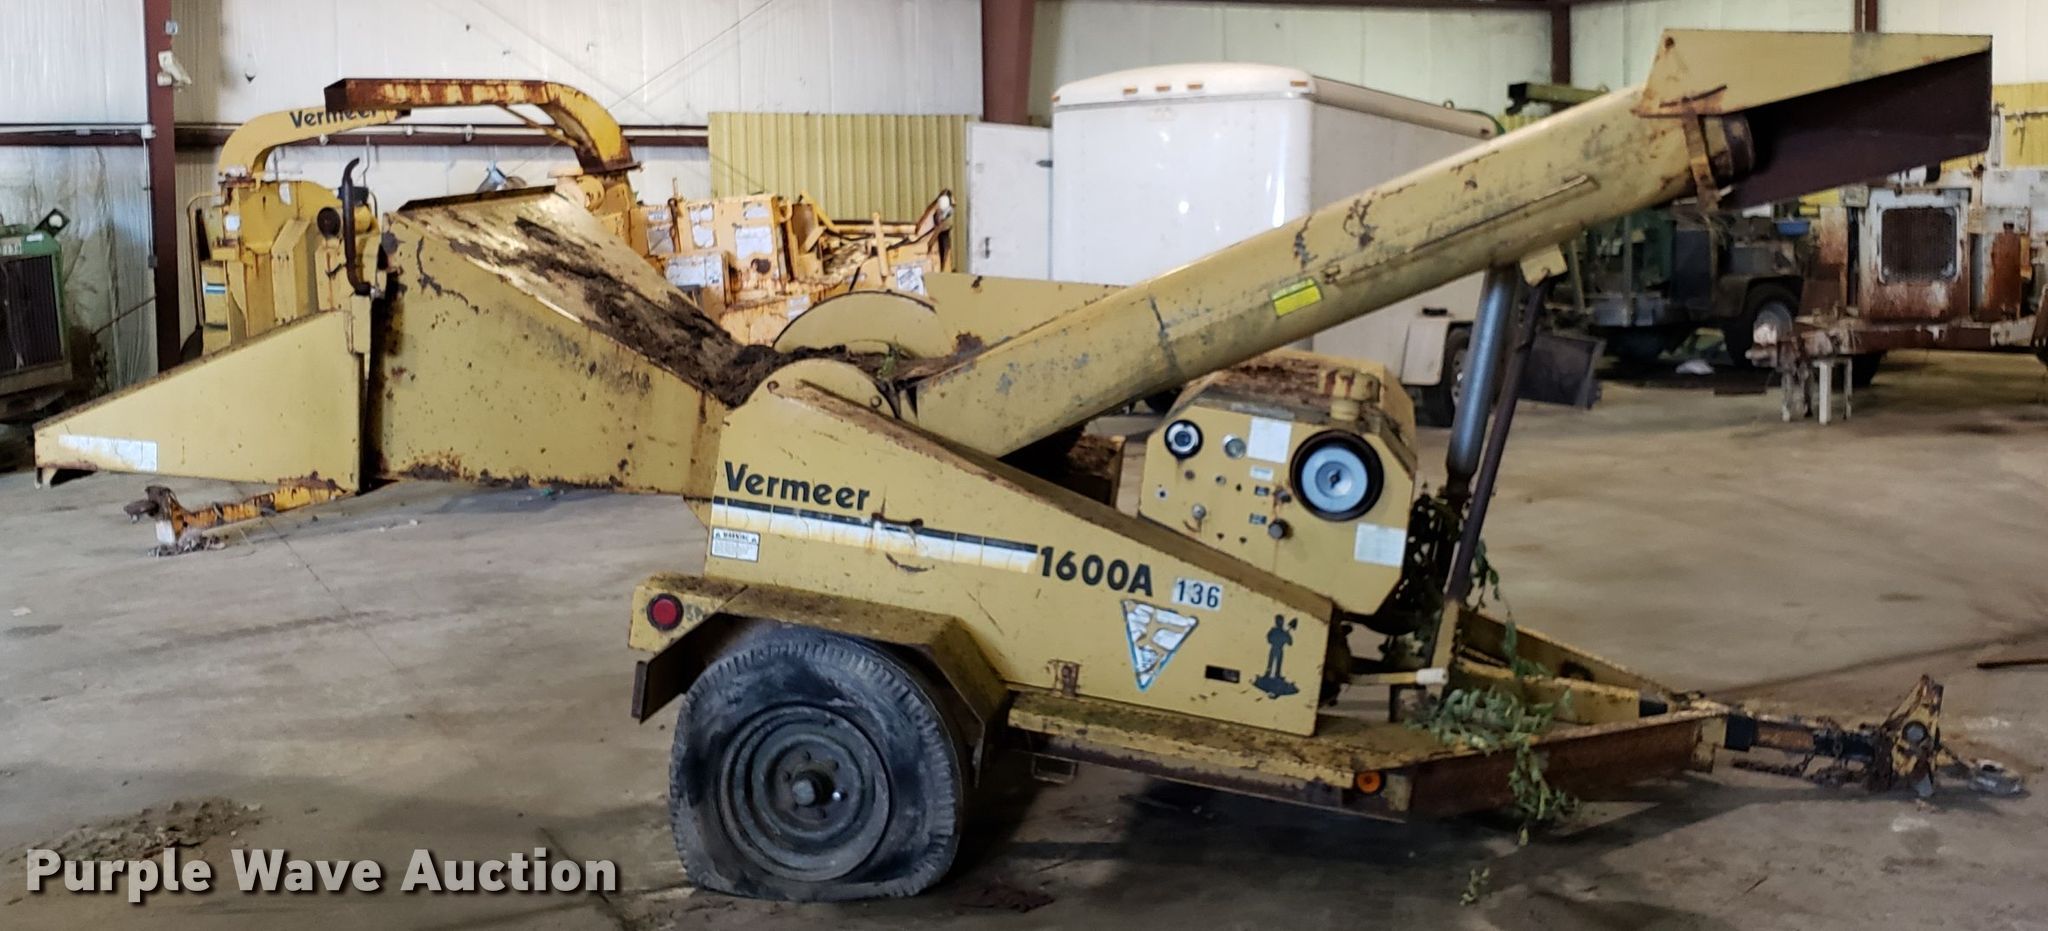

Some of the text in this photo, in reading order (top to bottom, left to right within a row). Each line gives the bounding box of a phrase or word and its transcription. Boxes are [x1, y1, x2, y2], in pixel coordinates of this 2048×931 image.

[724, 460, 870, 511] Vermeer
[1040, 546, 1153, 597] 1600A
[1177, 579, 1221, 608] 136
